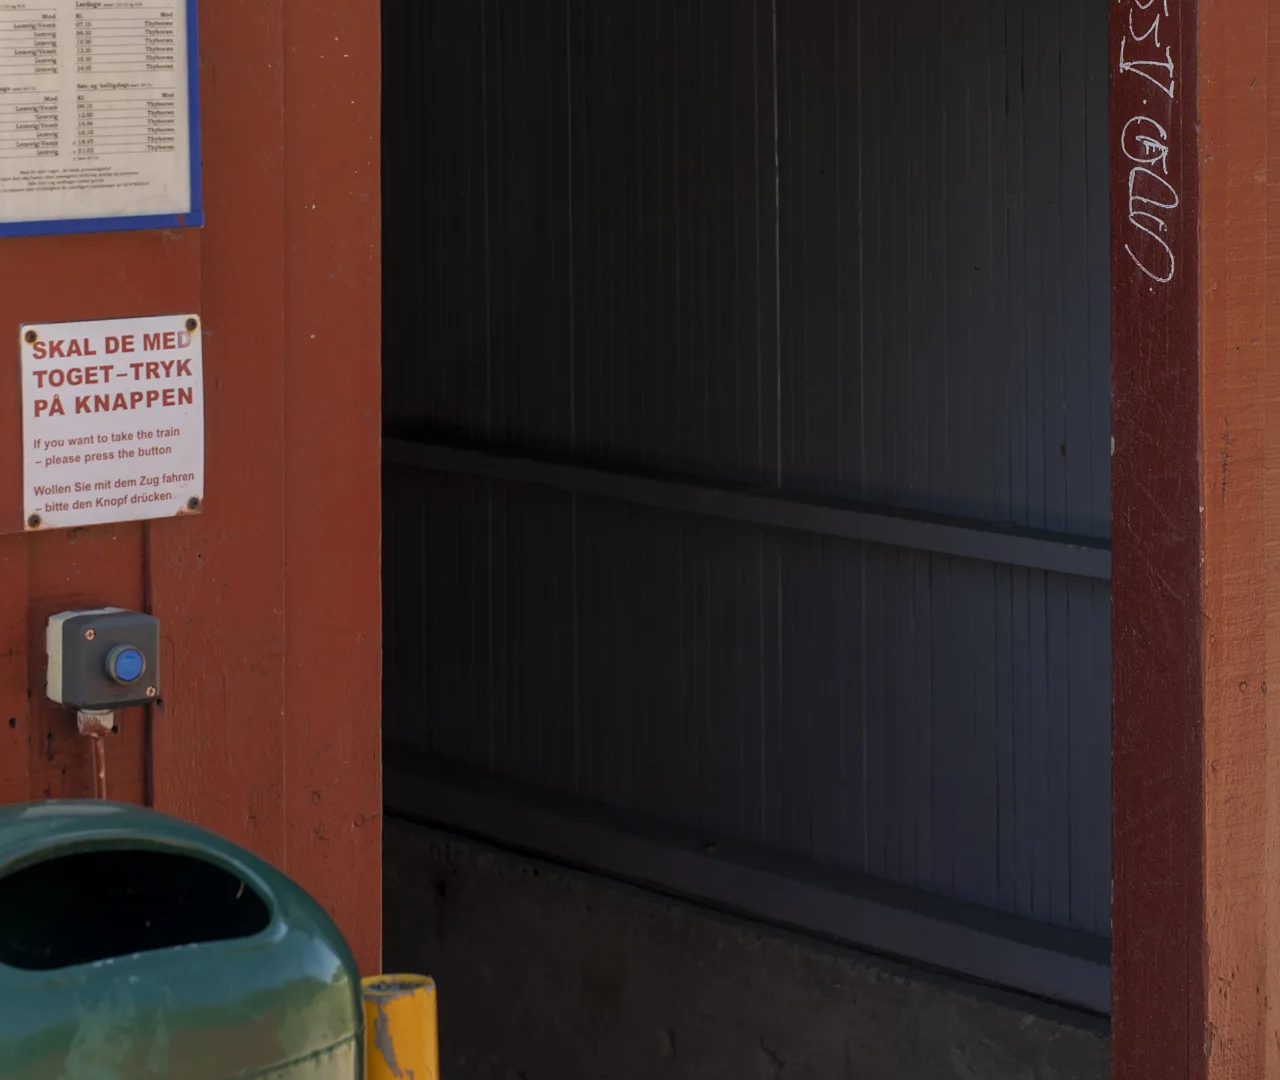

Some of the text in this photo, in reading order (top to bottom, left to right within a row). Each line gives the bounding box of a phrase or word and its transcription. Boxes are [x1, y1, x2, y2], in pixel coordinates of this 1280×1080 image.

[32, 330, 192, 360] SKAL DE MED
[33, 387, 193, 418] PÅ KNAPPEN
[33, 427, 180, 451] If you want to take the train
[45, 452, 81, 467] please
[84, 451, 114, 464] press
[118, 447, 135, 458] the
[138, 445, 172, 457] button
[33, 471, 194, 496] Wollen Sie mit dem Zug fahren
[45, 501, 69, 513] bitte
[72, 498, 93, 510] den
[95, 495, 128, 509] Knopf
[130, 491, 172, 504] drücken
